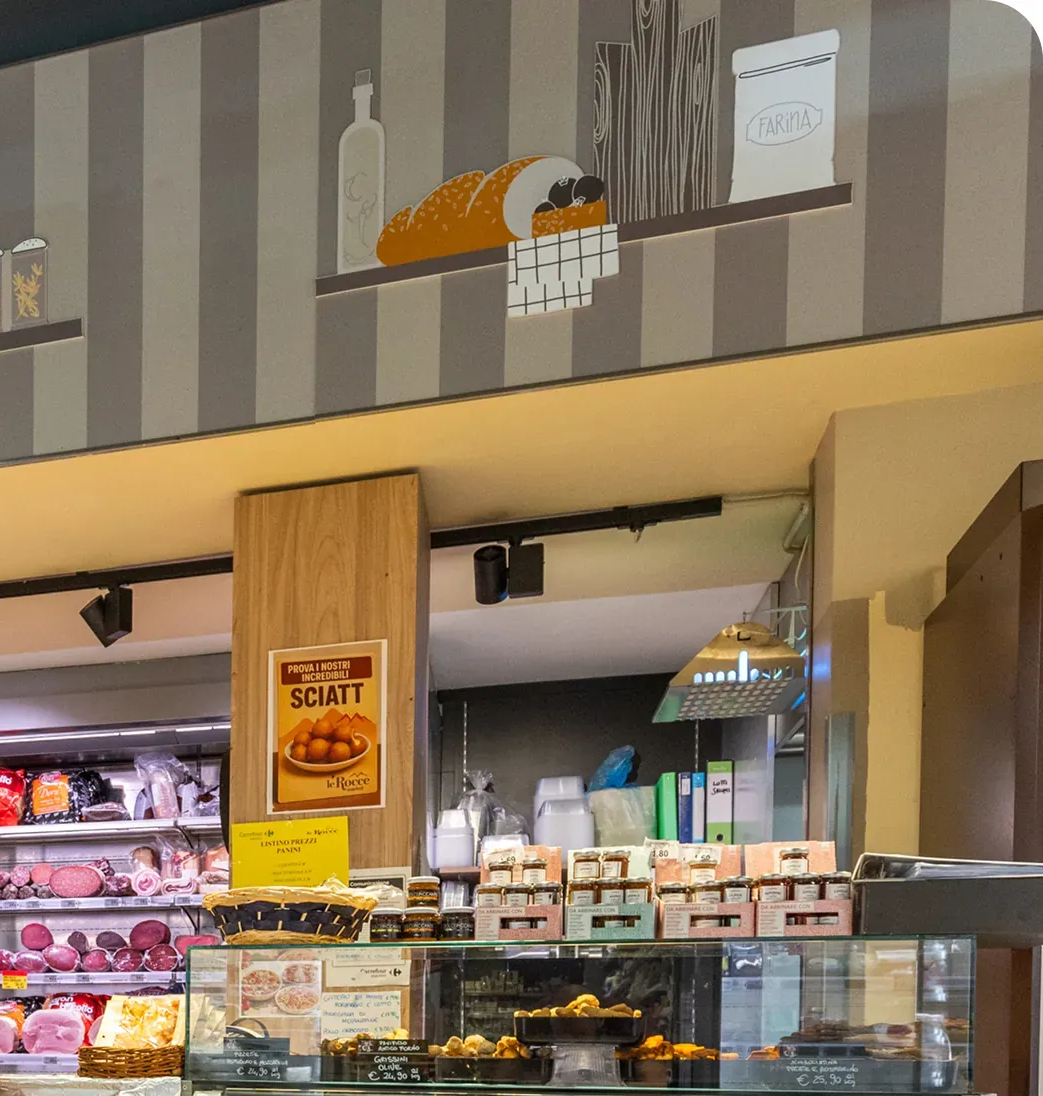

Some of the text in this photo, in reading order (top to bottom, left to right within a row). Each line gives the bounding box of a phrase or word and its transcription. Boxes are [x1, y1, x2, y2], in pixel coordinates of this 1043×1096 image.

[287, 660, 351, 674] PROVA I NOSTRI
[301, 670, 349, 682] INCREDIBILI
[290, 682, 364, 709] SCIATT
[335, 775, 371, 791] Rocce
[260, 837, 318, 848] LISTINO PREZZI
[276, 846, 302, 855] PANINI
[373, 1055, 409, 1064] GRISSINI
[377, 1062, 403, 1072] OLIVE
[367, 1070, 381, 1081] €
[796, 1073, 811, 1086] €
